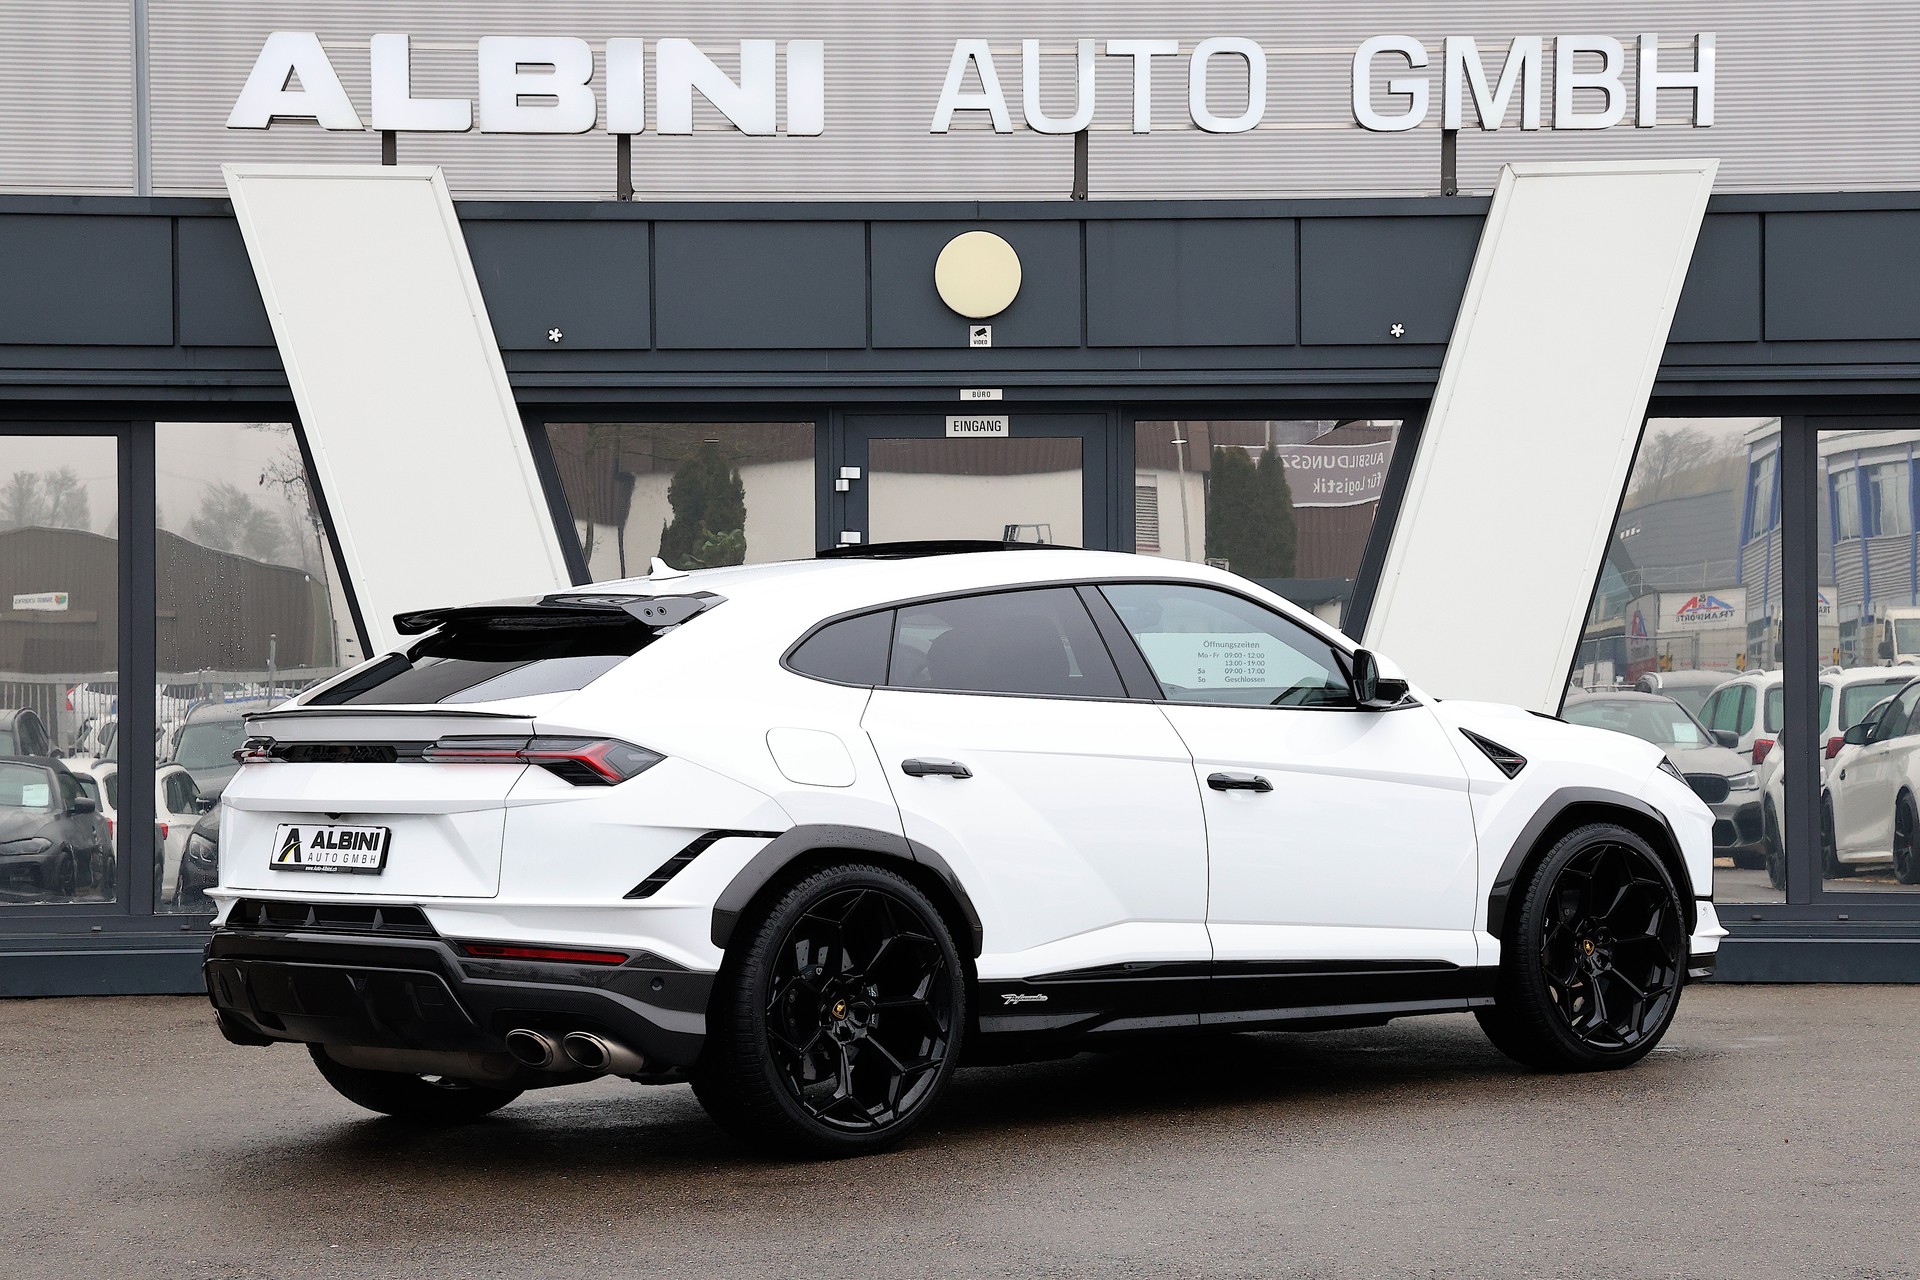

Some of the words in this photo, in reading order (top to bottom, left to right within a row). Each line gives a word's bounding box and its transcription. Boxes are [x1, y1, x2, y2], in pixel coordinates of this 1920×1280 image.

[226, 30, 825, 136] ALBINI
[929, 36, 1267, 135] AUTO
[1350, 31, 1717, 132] GMBH
[972, 389, 991, 398] BÜRO
[953, 420, 1002, 432] EINGANG
[1203, 639, 1260, 649] Öffnungszeiten
[310, 830, 381, 851] ALBINI
[307, 852, 338, 863] AUTO
[343, 853, 377, 864] GMBH
